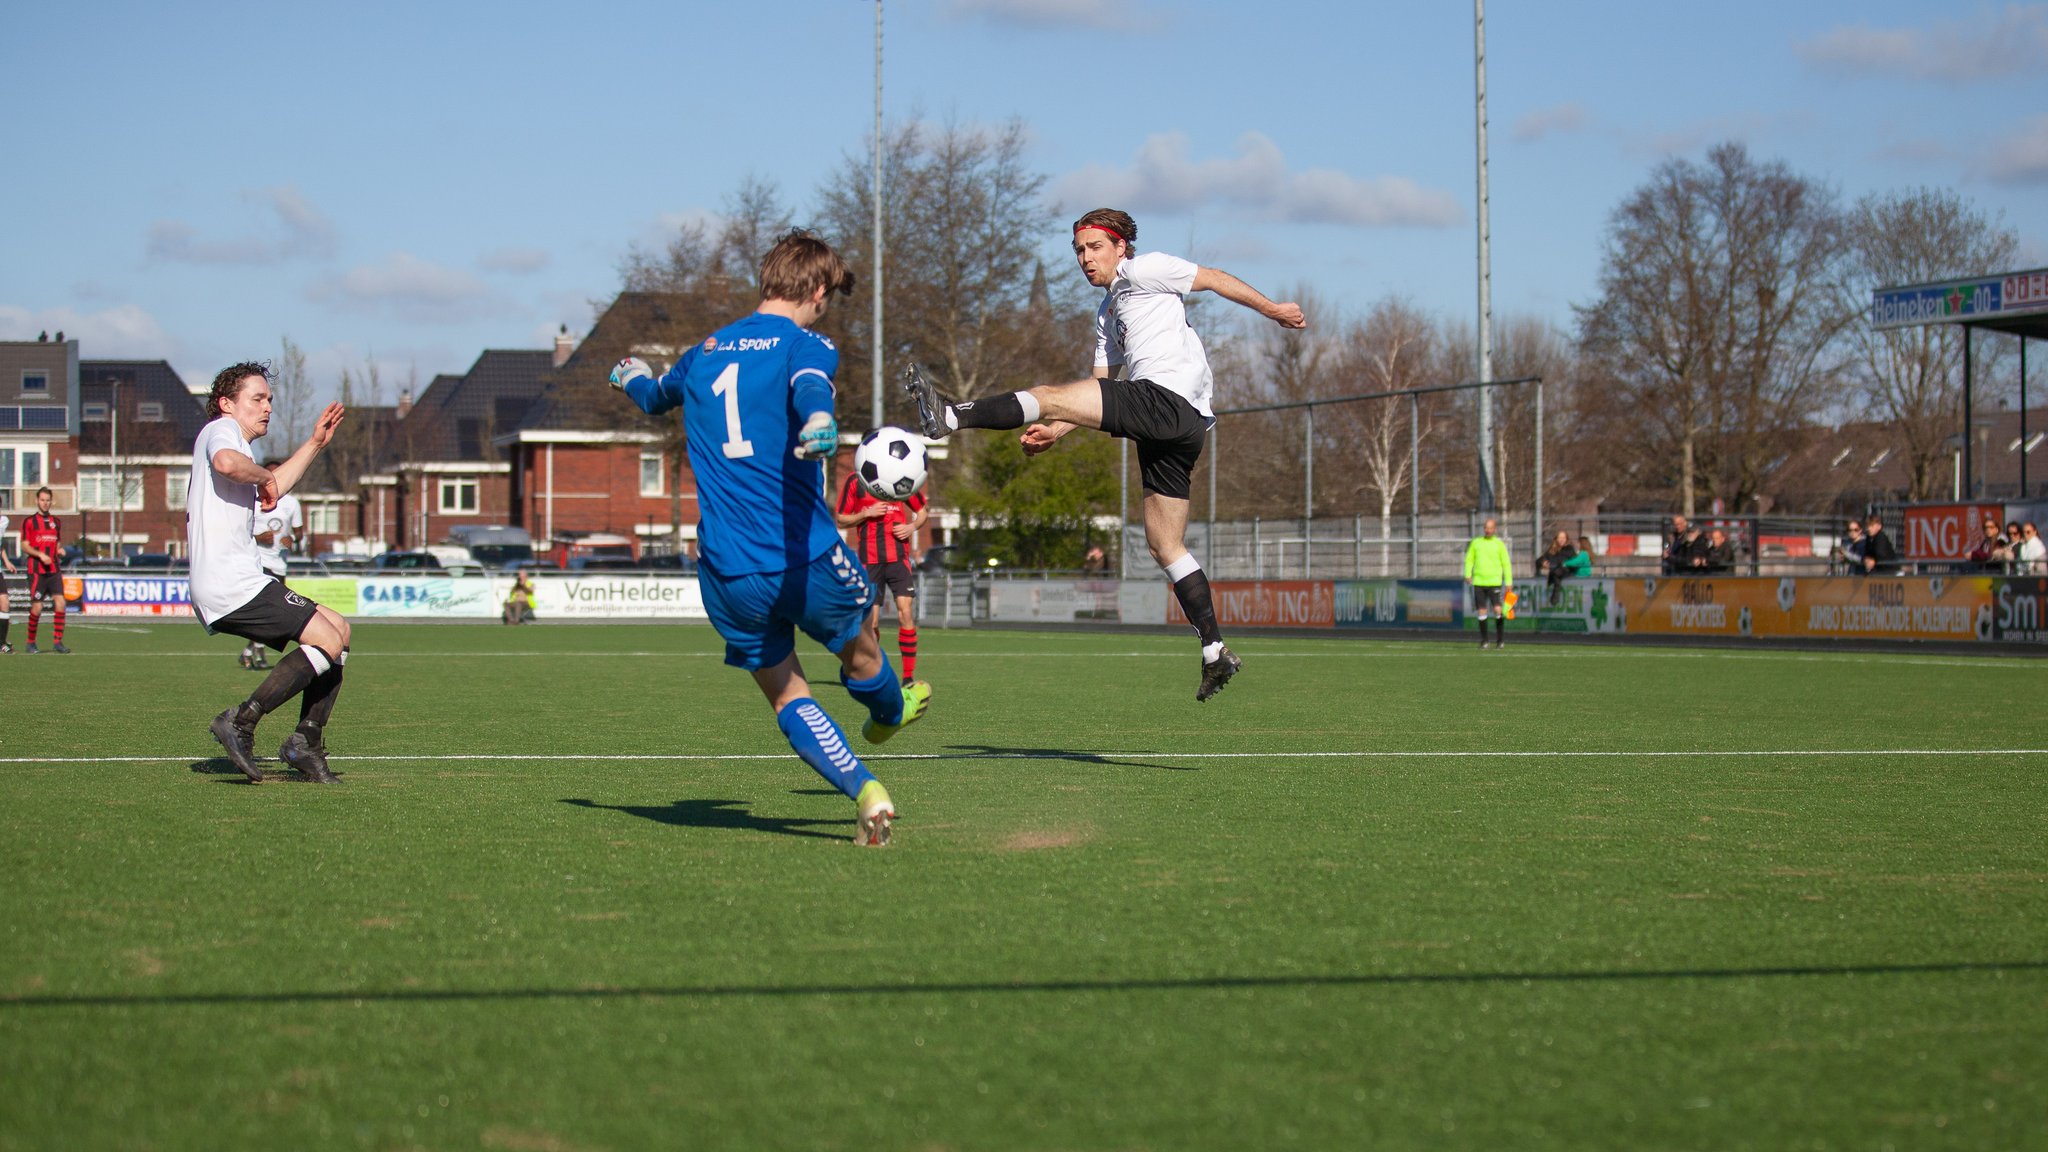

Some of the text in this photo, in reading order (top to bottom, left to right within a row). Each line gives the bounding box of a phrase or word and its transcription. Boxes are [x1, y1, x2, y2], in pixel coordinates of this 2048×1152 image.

[1874, 292, 1945, 324] Heineken
[738, 337, 780, 351] SPORT
[711, 362, 754, 459] 1
[1908, 515, 1959, 557] ING
[85, 581, 162, 601] WATSON
[564, 581, 685, 601] VanHelder
[1868, 583, 1904, 606] HALLO
[1222, 591, 1309, 623] ING ING
[1808, 606, 1840, 630] JUMBO
[1842, 606, 1910, 632] ZOETERWOUDE
